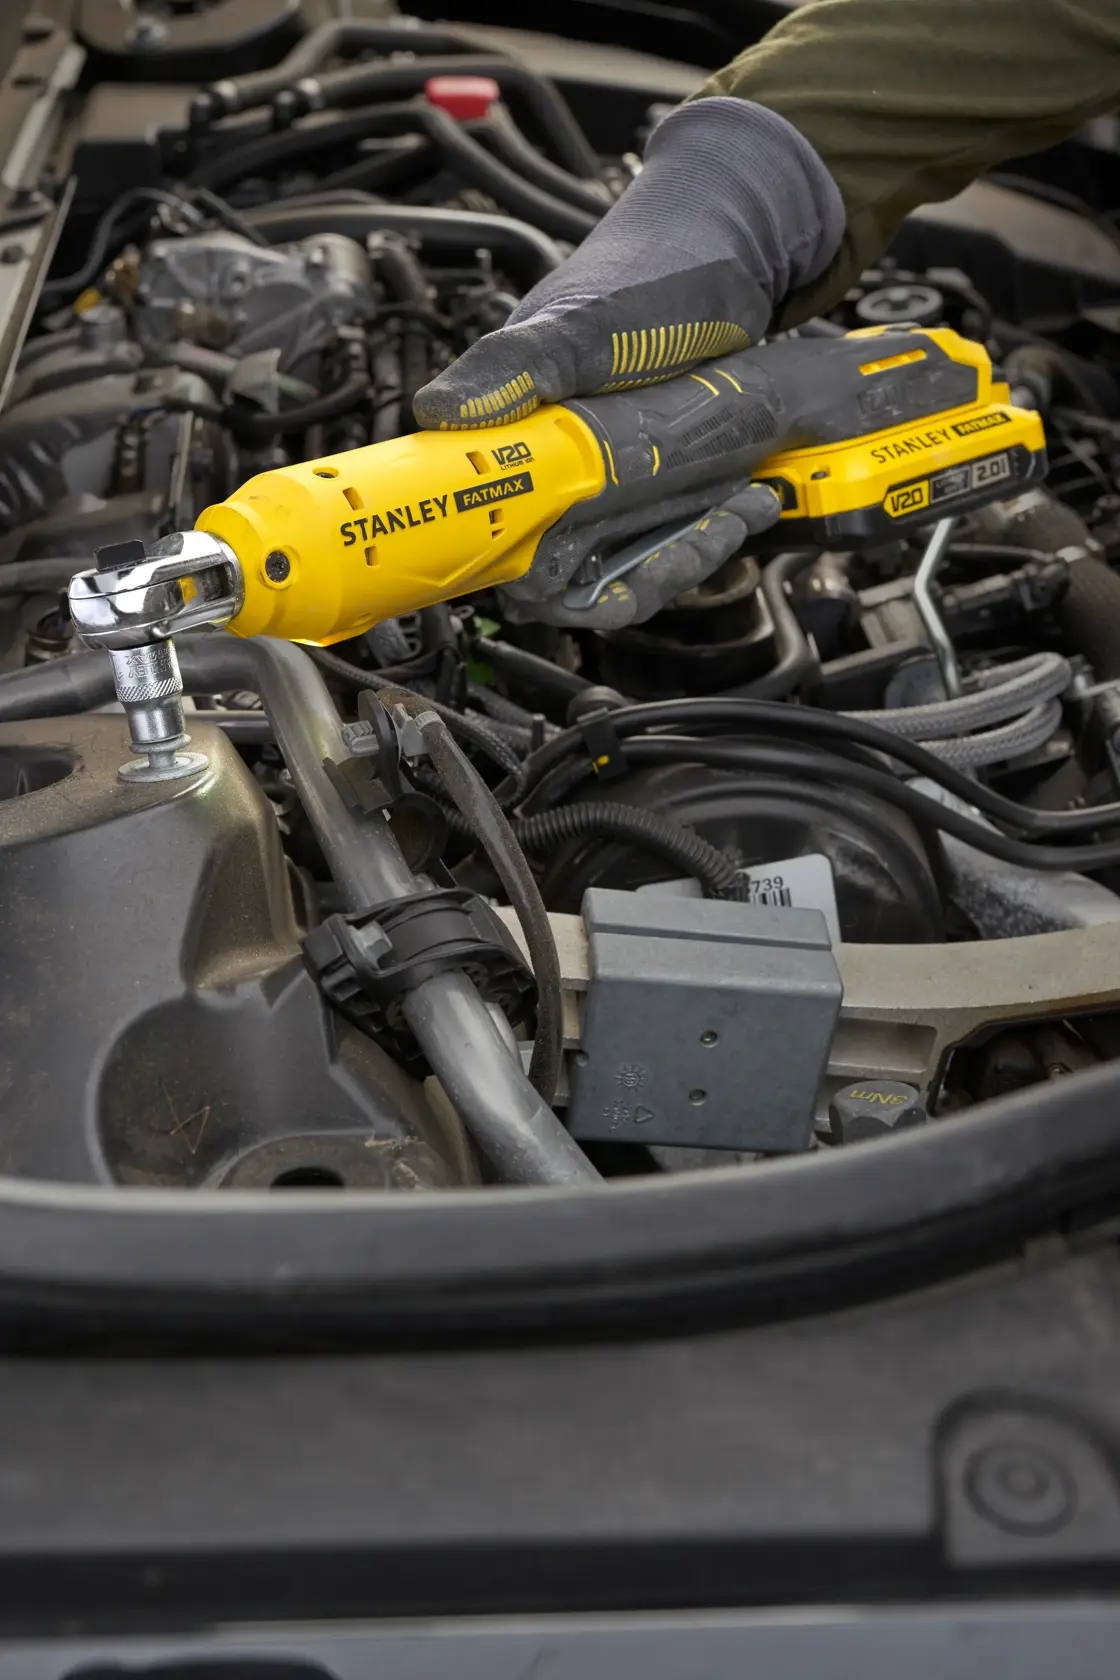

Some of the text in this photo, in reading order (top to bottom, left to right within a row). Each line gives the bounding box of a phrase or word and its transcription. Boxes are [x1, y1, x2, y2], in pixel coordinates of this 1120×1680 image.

[491, 441, 532, 466] V20
[870, 427, 952, 464] STANLEY
[500, 459, 525, 471] LITHIUM
[340, 478, 525, 546] STANLEY FATMAX
[890, 487, 923, 512] V20
[750, 875, 784, 894] 739
